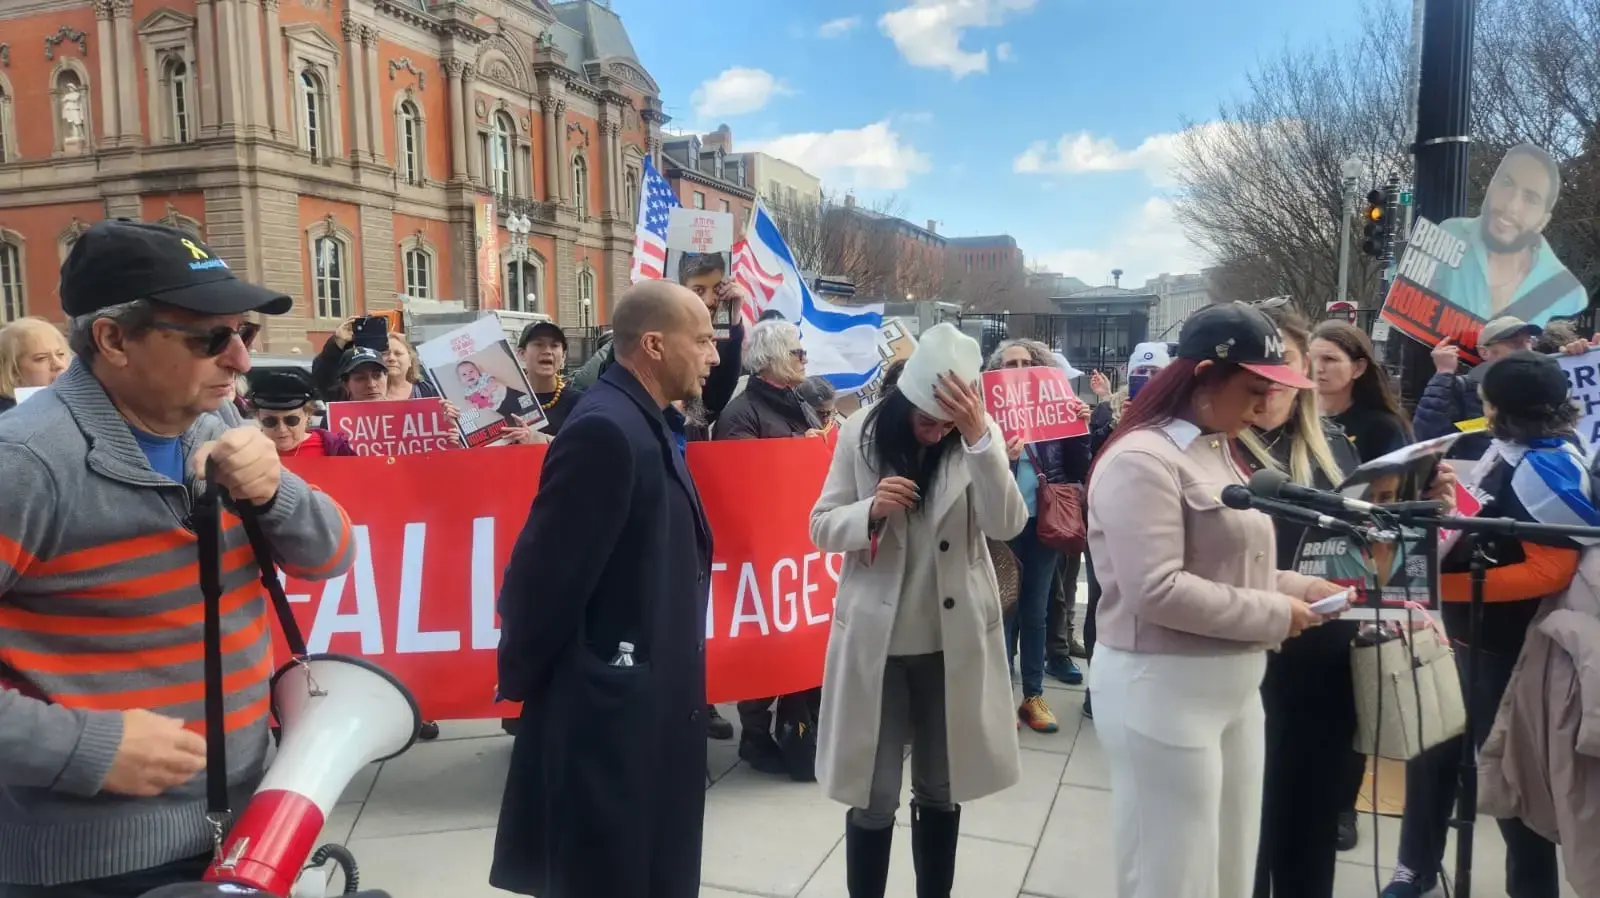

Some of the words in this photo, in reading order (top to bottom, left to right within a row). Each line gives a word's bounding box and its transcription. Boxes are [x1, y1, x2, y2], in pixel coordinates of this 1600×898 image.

[486, 204, 496, 246] Renwick
[1411, 218, 1467, 269] BRING
[488, 249, 497, 286] Gallery
[1400, 247, 1439, 288] HIM
[1386, 280, 1440, 328] HOME
[992, 382, 1034, 408] SAVE
[1039, 380, 1073, 402] ALL
[340, 415, 396, 442] SAVE
[402, 412, 449, 438] ALL
[995, 401, 1077, 432] HOSTAGES
[350, 438, 447, 456] OSTAGES
[1302, 540, 1347, 557] BRING
[305, 516, 501, 654] ALL
